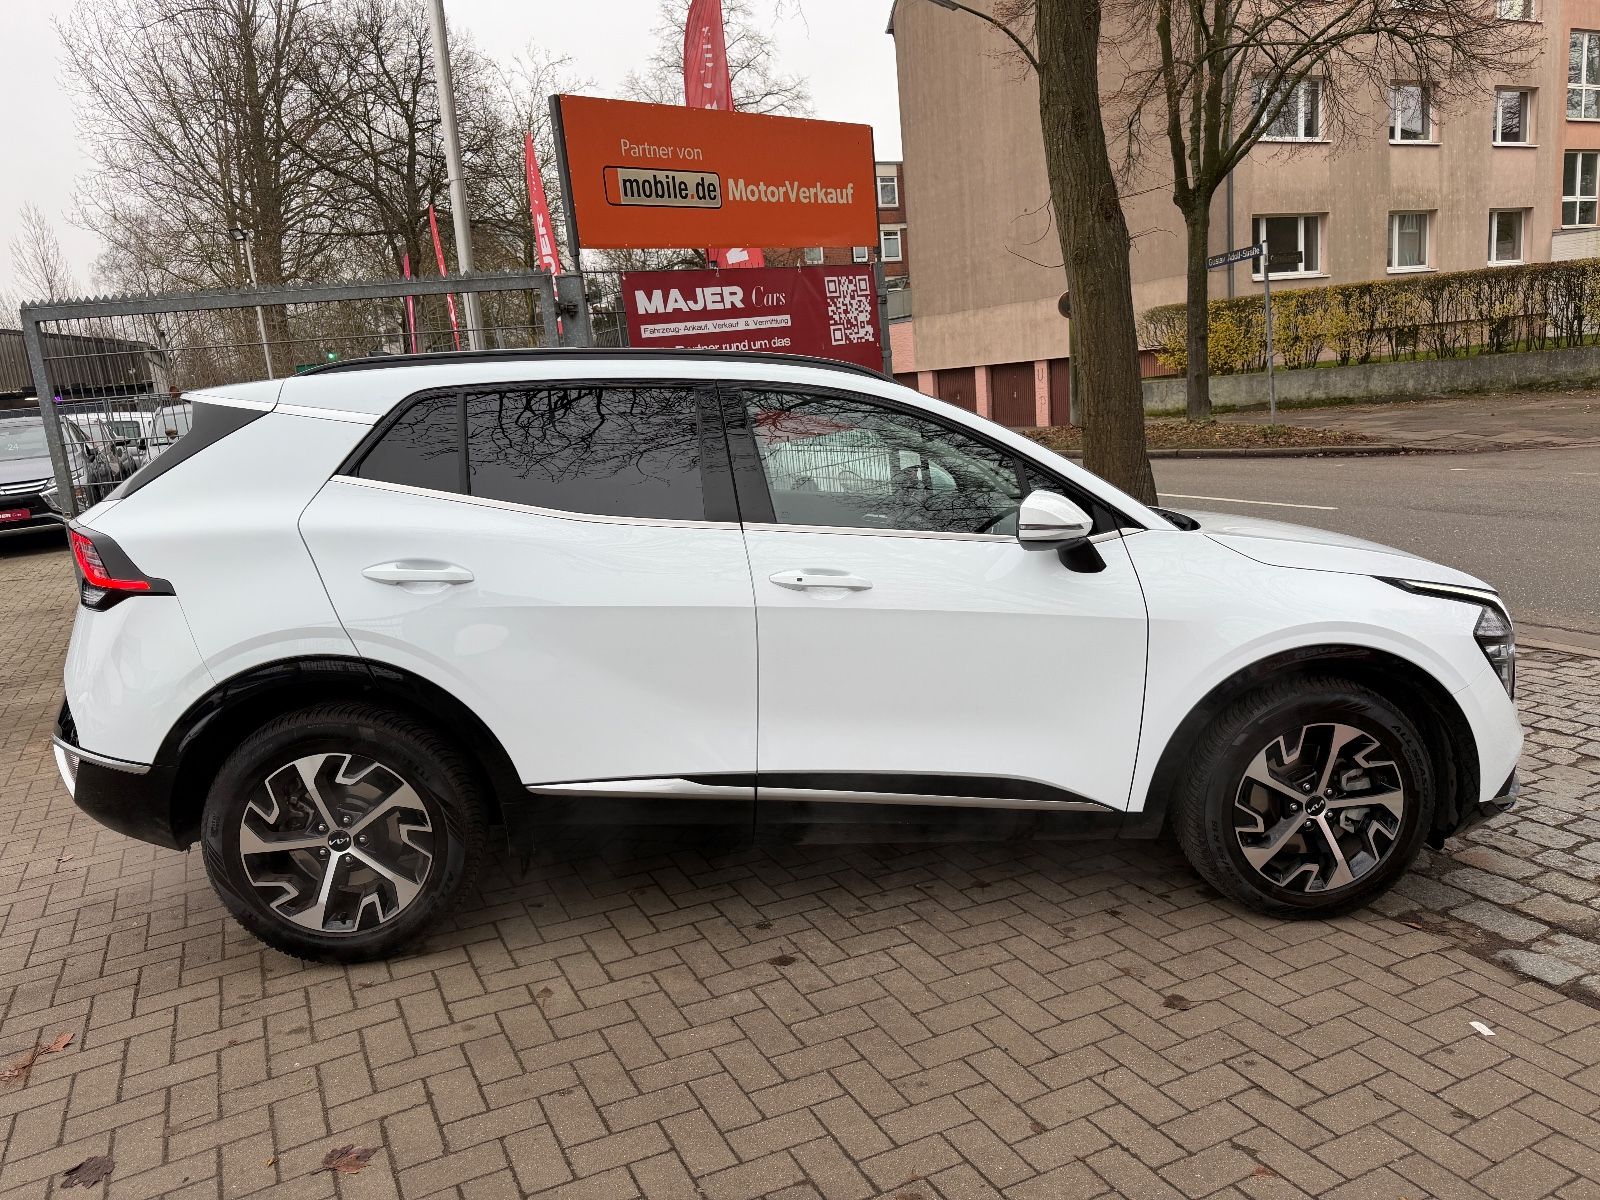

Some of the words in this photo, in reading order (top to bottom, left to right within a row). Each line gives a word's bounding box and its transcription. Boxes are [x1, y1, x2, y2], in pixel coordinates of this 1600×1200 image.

[620, 138, 674, 159] Partner
[677, 147, 703, 161] von
[622, 174, 717, 201] mobile.de
[727, 178, 854, 204] MotorVerkauf
[634, 285, 745, 315] MAJER
[751, 285, 786, 308] Cars
[711, 320, 739, 330] Verkauf
[722, 340, 749, 351] rund
[750, 340, 769, 350] um
[771, 336, 791, 347] das
